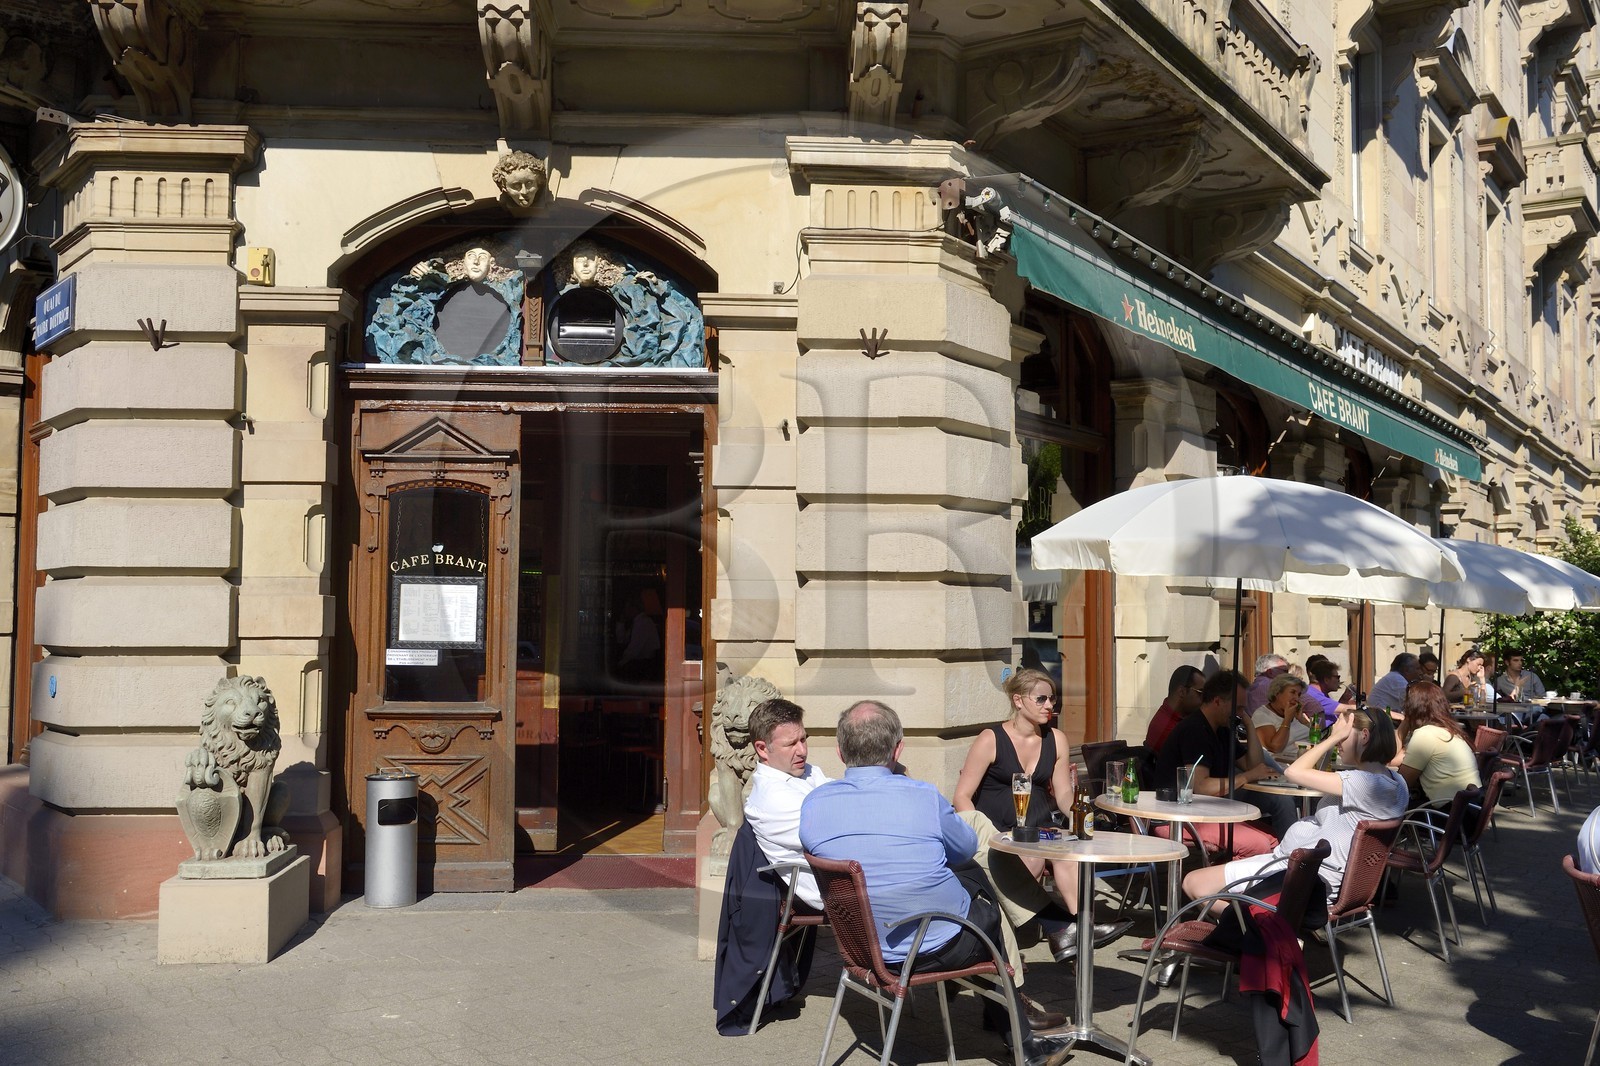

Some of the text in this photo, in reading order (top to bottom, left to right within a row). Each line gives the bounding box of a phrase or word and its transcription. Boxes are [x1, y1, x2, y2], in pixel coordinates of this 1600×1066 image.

[1134, 299, 1197, 352] Heineken
[1308, 381, 1370, 434] CAFE BRANT
[390, 554, 487, 573] CAFE BRANT
